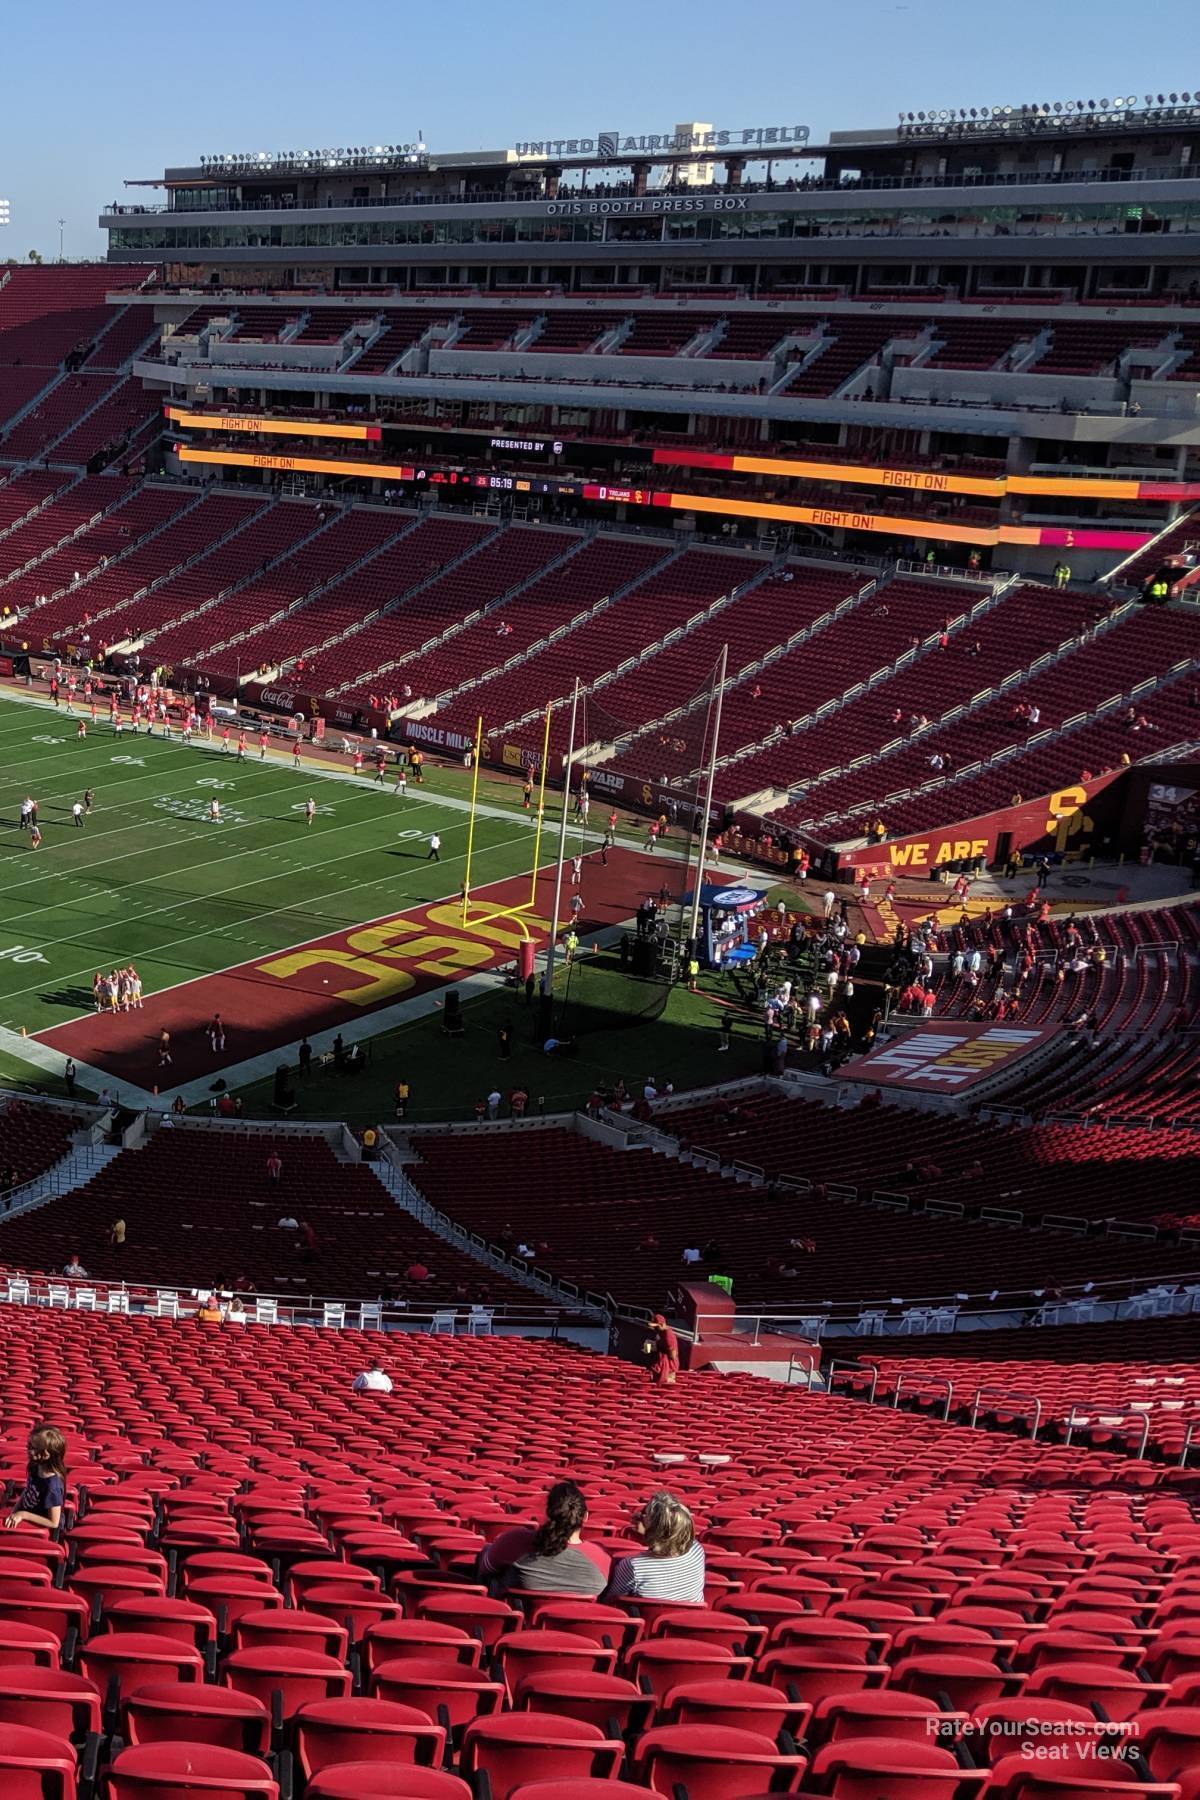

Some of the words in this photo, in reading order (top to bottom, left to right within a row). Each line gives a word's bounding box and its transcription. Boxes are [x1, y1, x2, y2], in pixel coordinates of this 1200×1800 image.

[515, 138, 594, 157] UNITED
[624, 130, 731, 151] AIRLINES
[742, 125, 810, 145] FIELD
[547, 203, 582, 215] OTIS
[589, 201, 643, 214] BOOTH
[652, 200, 704, 212] PRESS
[714, 198, 749, 210] BOX
[221, 418, 246, 430] FIGHT
[247, 420, 262, 432] ON!
[491, 440, 533, 450] PRESENTED
[534, 443, 544, 451] BY
[253, 456, 278, 467] FIGHT
[280, 457, 295, 469] ON!
[882, 471, 921, 488] FIGHT
[924, 475, 948, 489] ON!
[609, 489, 630, 498] TROJANS
[812, 510, 849, 527] FIGHT
[852, 514, 875, 528] ON!
[406, 721, 445, 745] MUSCLE
[890, 845, 928, 866] WE
[938, 838, 989, 863] ARE
[254, 900, 578, 1007] USC
[863, 1033, 970, 1072] MILK
[904, 1027, 1043, 1084] MUSCLE
